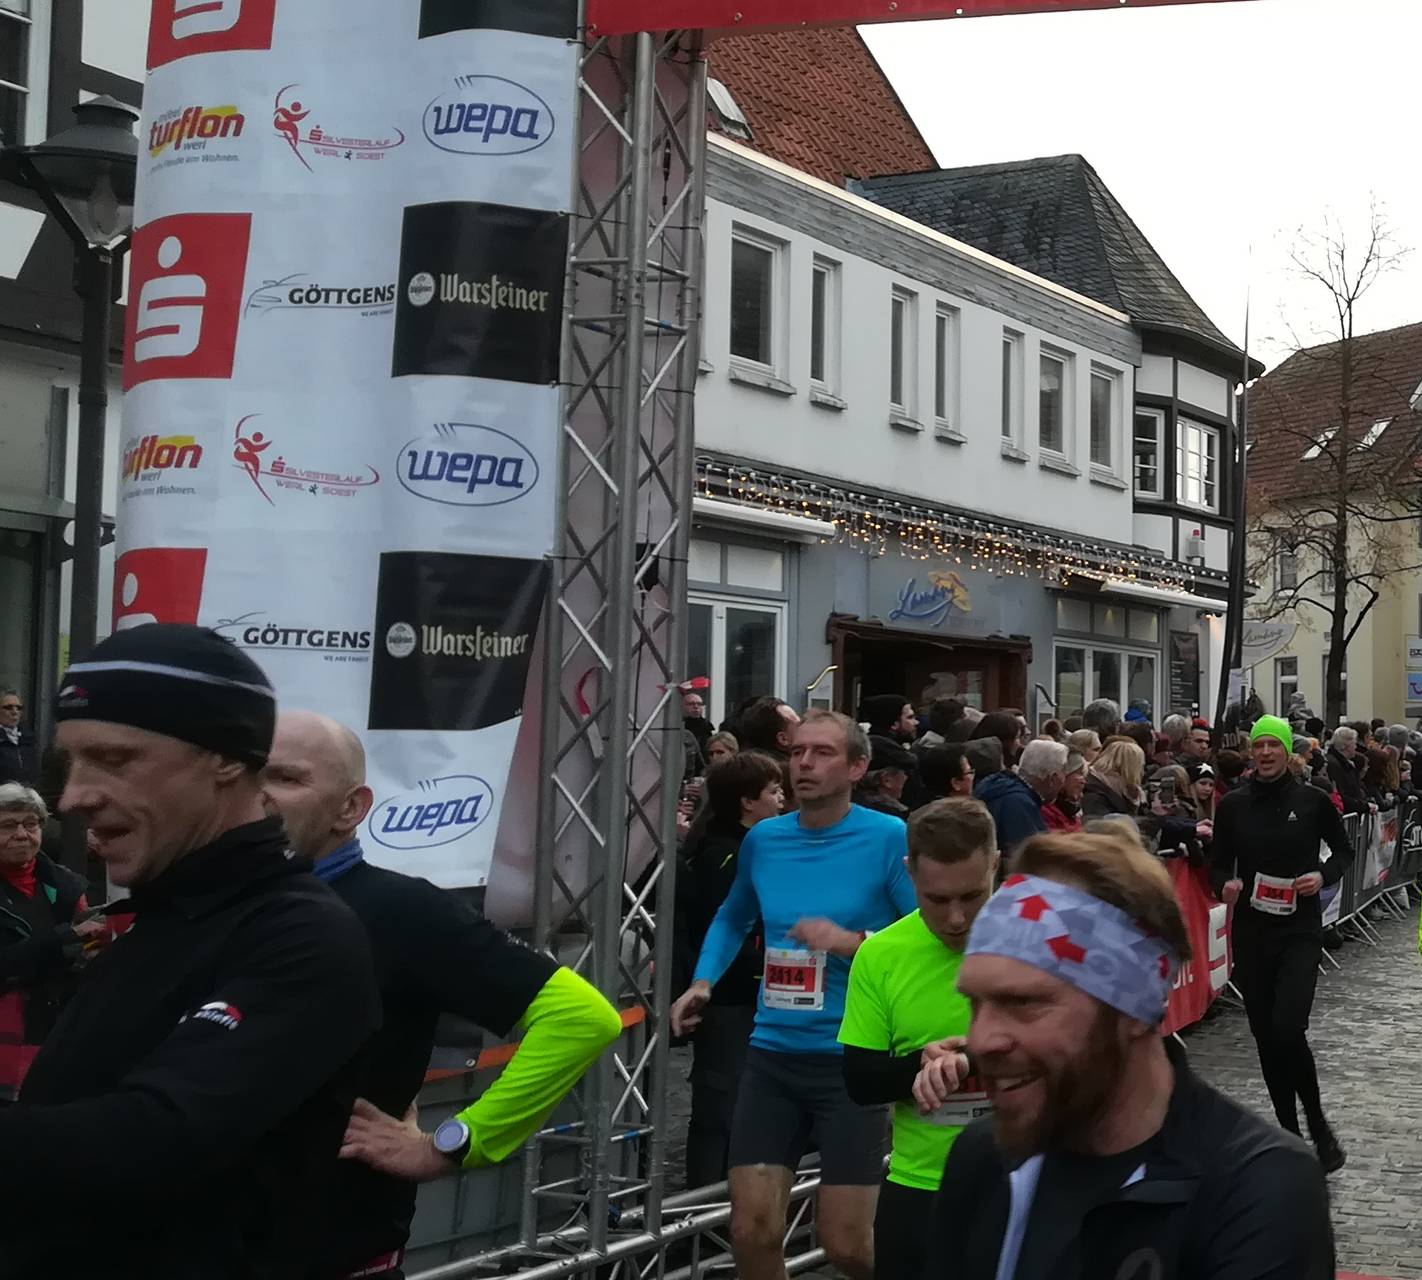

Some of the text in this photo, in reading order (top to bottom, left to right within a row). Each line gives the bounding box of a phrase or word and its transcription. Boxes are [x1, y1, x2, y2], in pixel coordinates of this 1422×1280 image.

[148, 106, 245, 151] turflon
[322, 135, 391, 147] SILVESTERLAUF
[433, 103, 540, 143] wepa
[288, 284, 396, 305] GÖTTGENS
[439, 272, 549, 312] Warsteiner
[285, 467, 364, 482] SILVESTERLAUF
[408, 450, 524, 494] wepa
[243, 624, 371, 649] GÖTTGENS
[421, 624, 529, 661] Warsteiner
[381, 794, 484, 837] wepa
